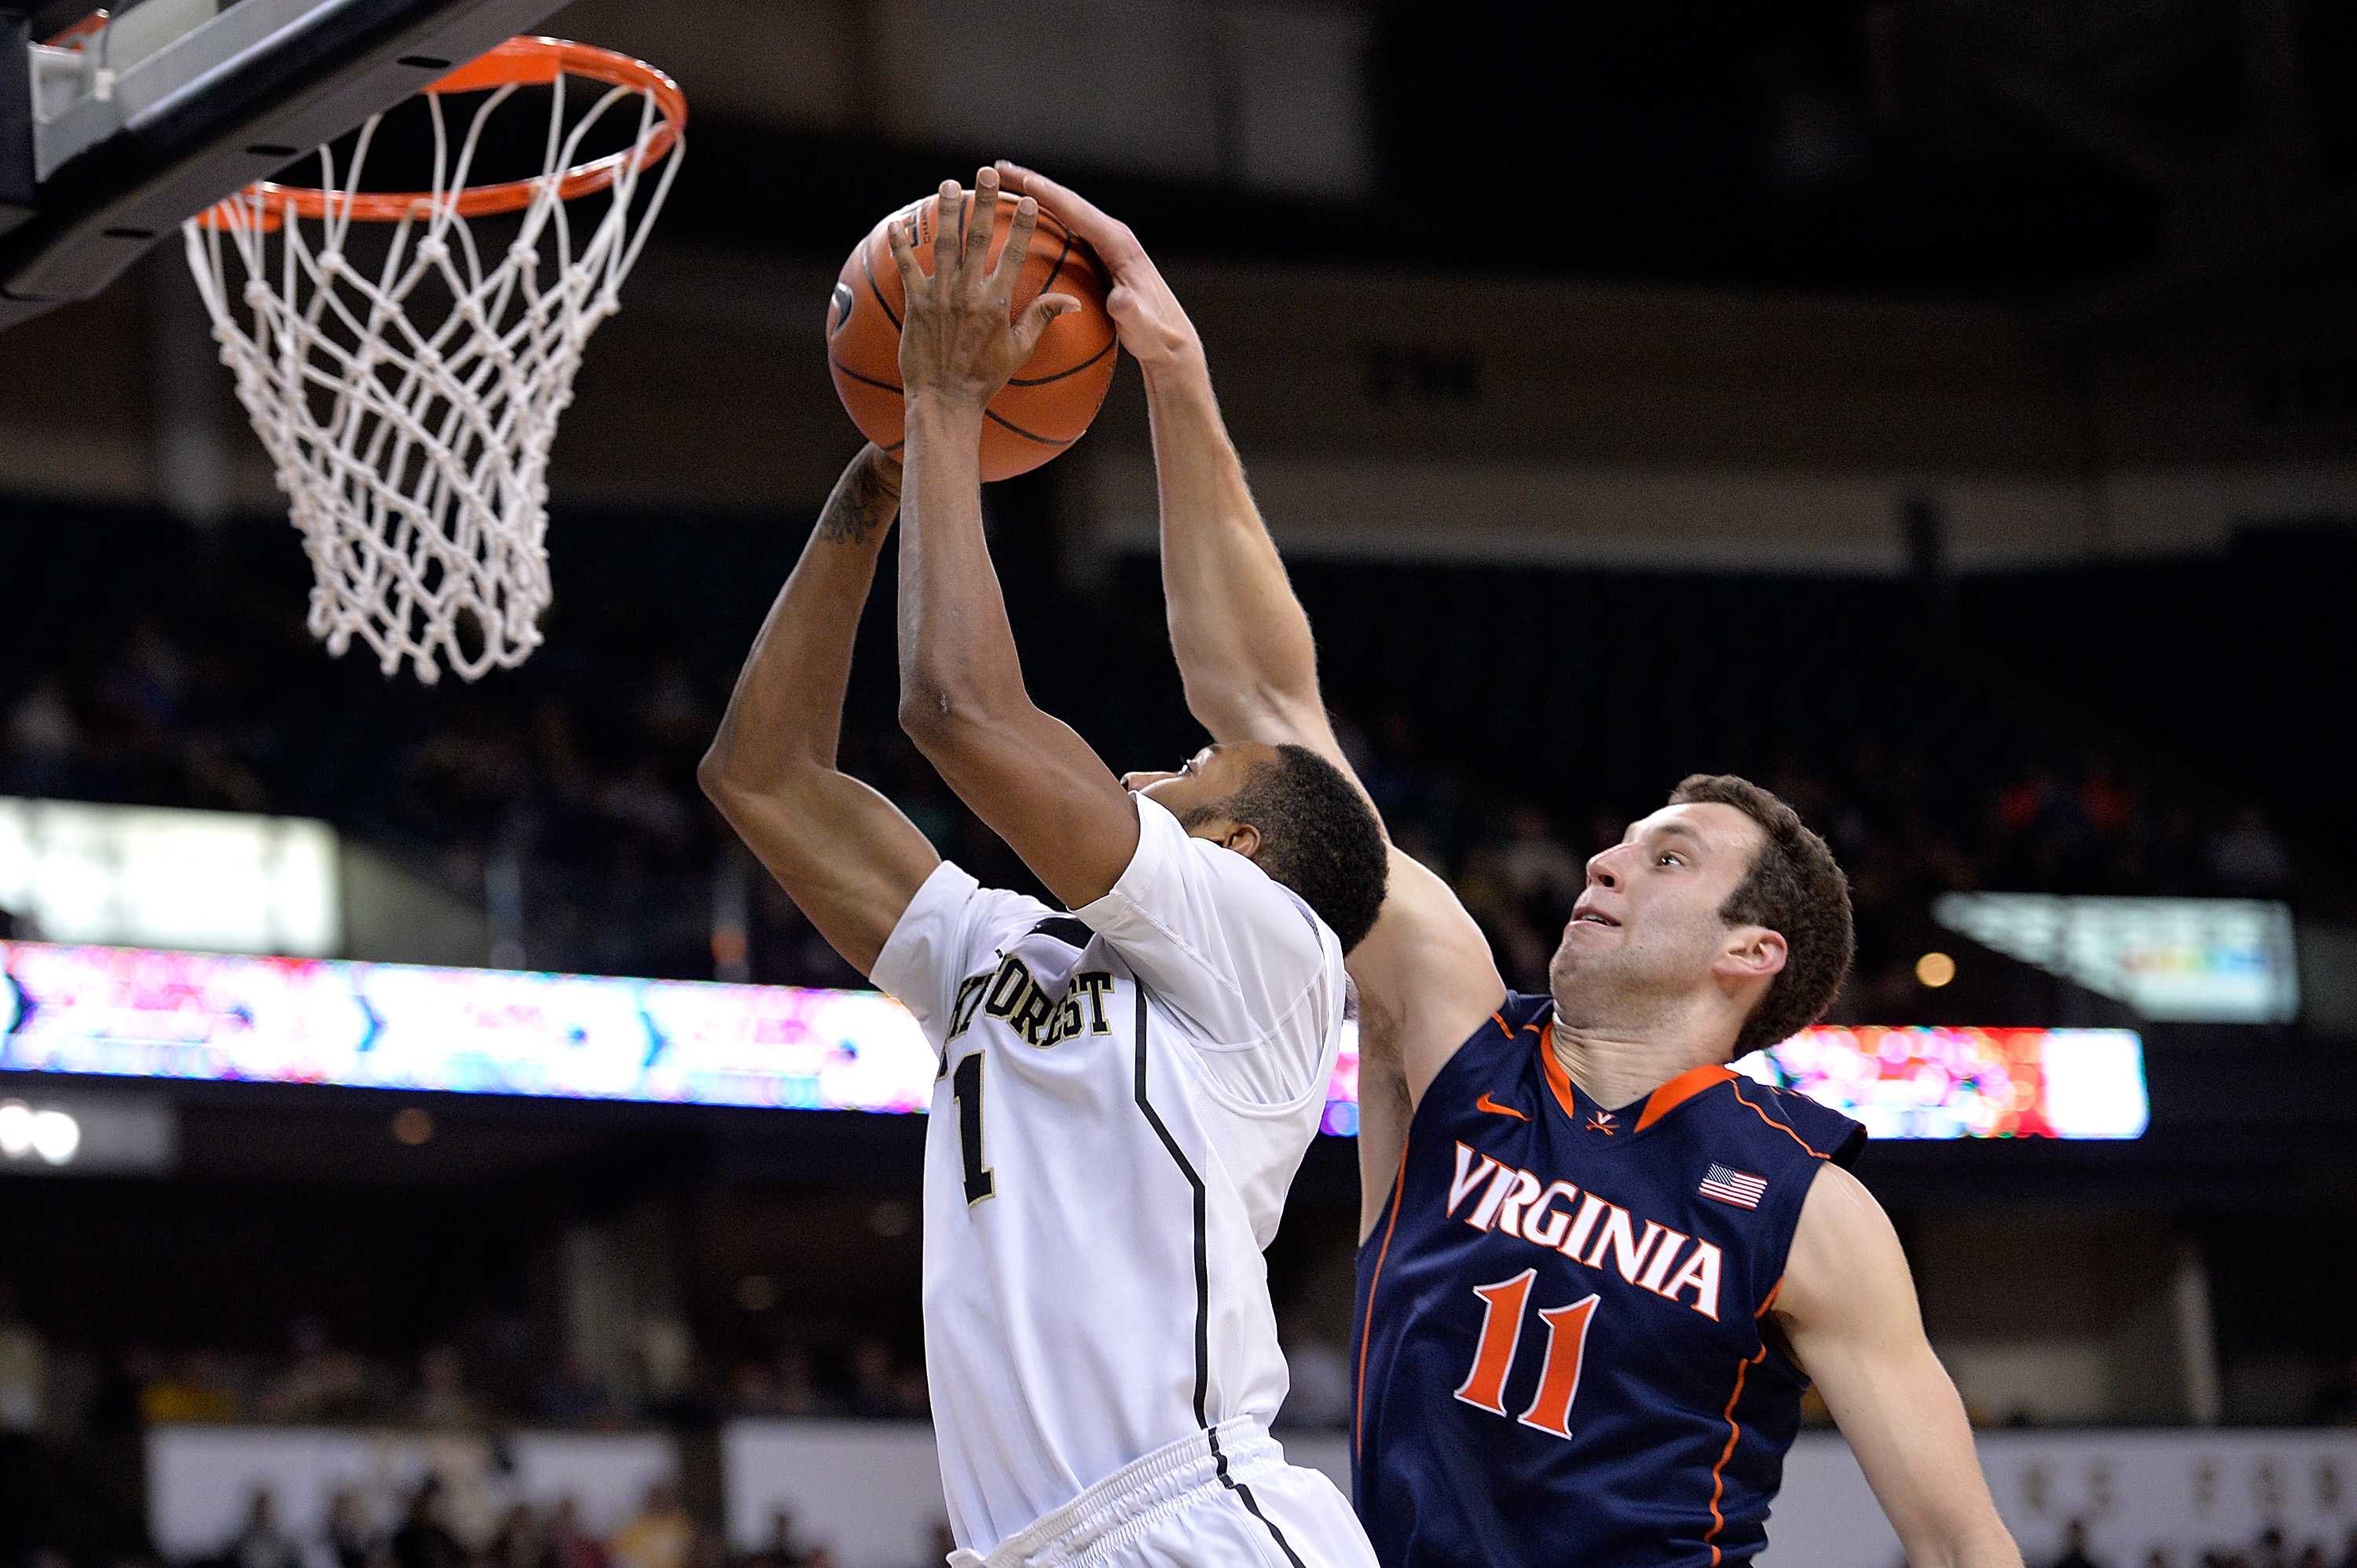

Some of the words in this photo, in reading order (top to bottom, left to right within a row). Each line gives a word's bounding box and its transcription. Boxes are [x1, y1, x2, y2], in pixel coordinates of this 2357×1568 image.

[953, 1050, 995, 1210] 1
[1446, 1141, 1722, 1321] VIRGINIA
[1453, 1268, 1601, 1440] 11
